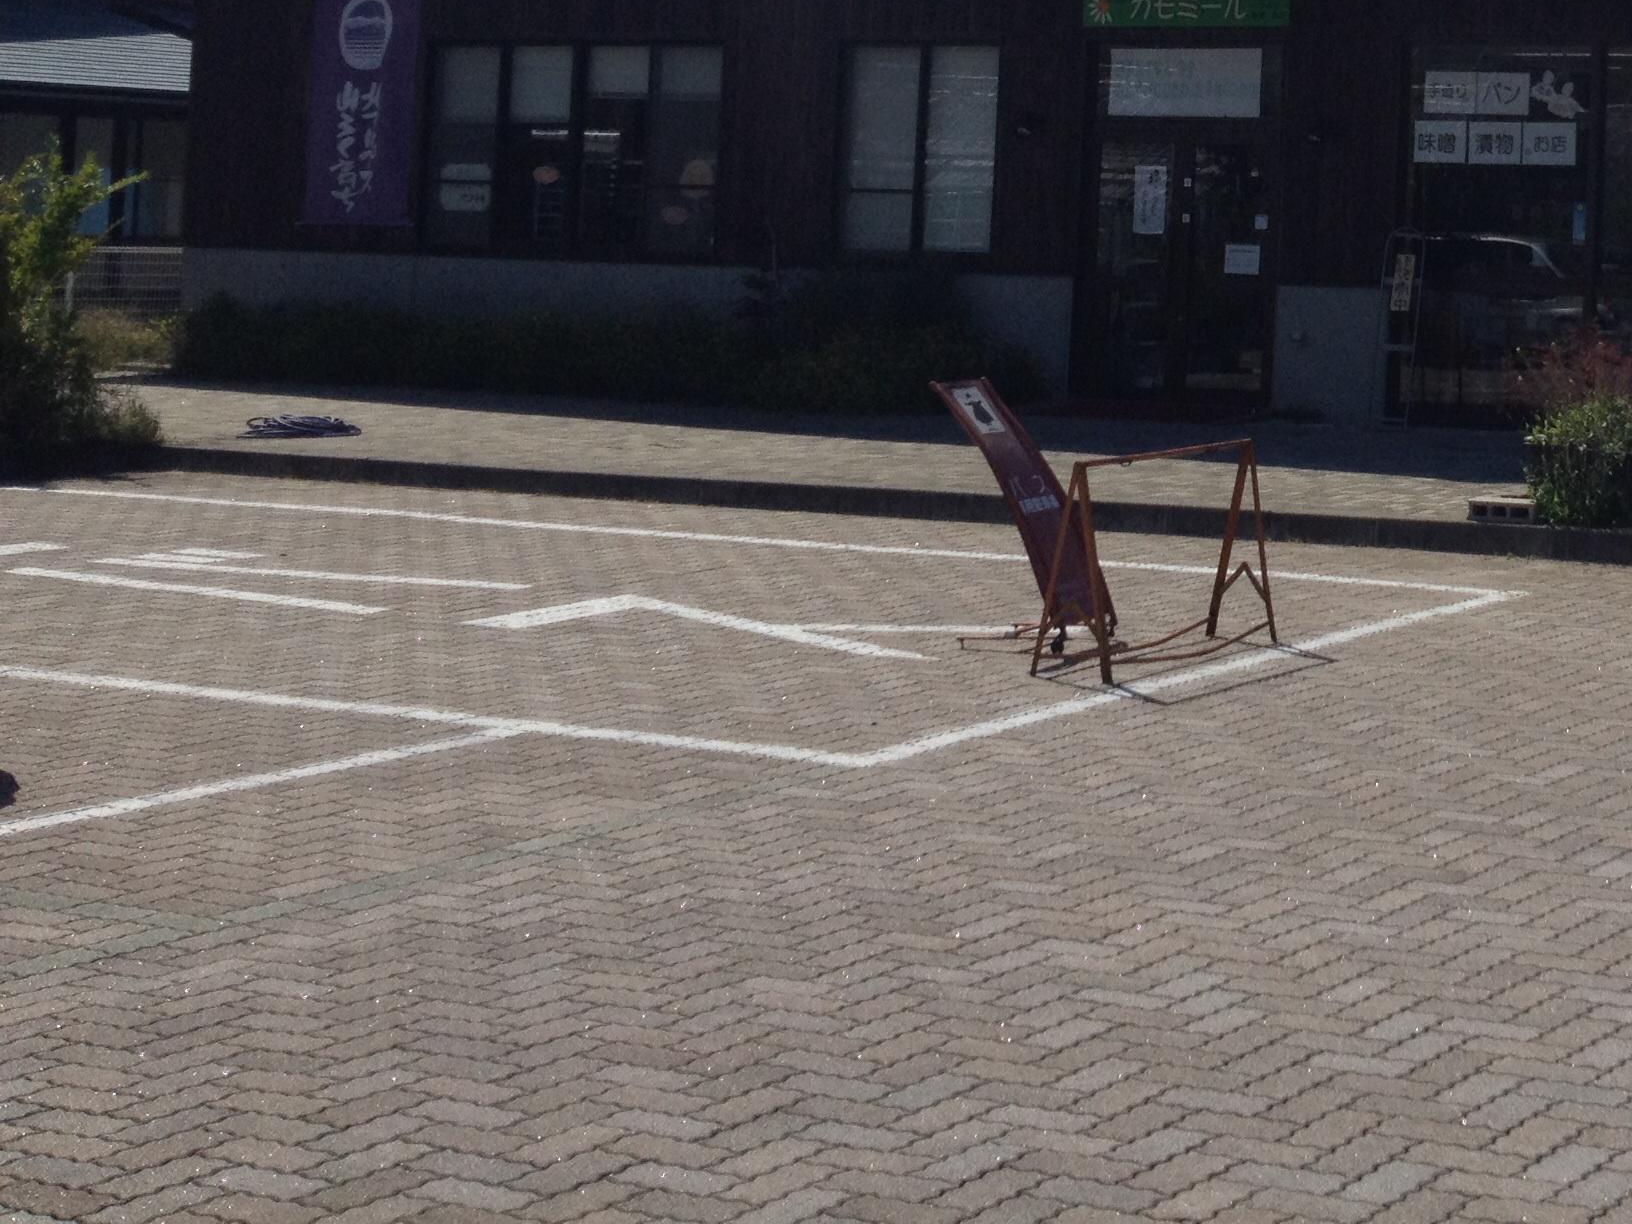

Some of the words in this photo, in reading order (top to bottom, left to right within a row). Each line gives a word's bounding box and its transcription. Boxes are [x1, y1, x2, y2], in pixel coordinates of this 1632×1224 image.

[1482, 82, 1521, 105] パン
[1418, 132, 1456, 154] 味噌
[1475, 133, 1514, 155] 漬物
